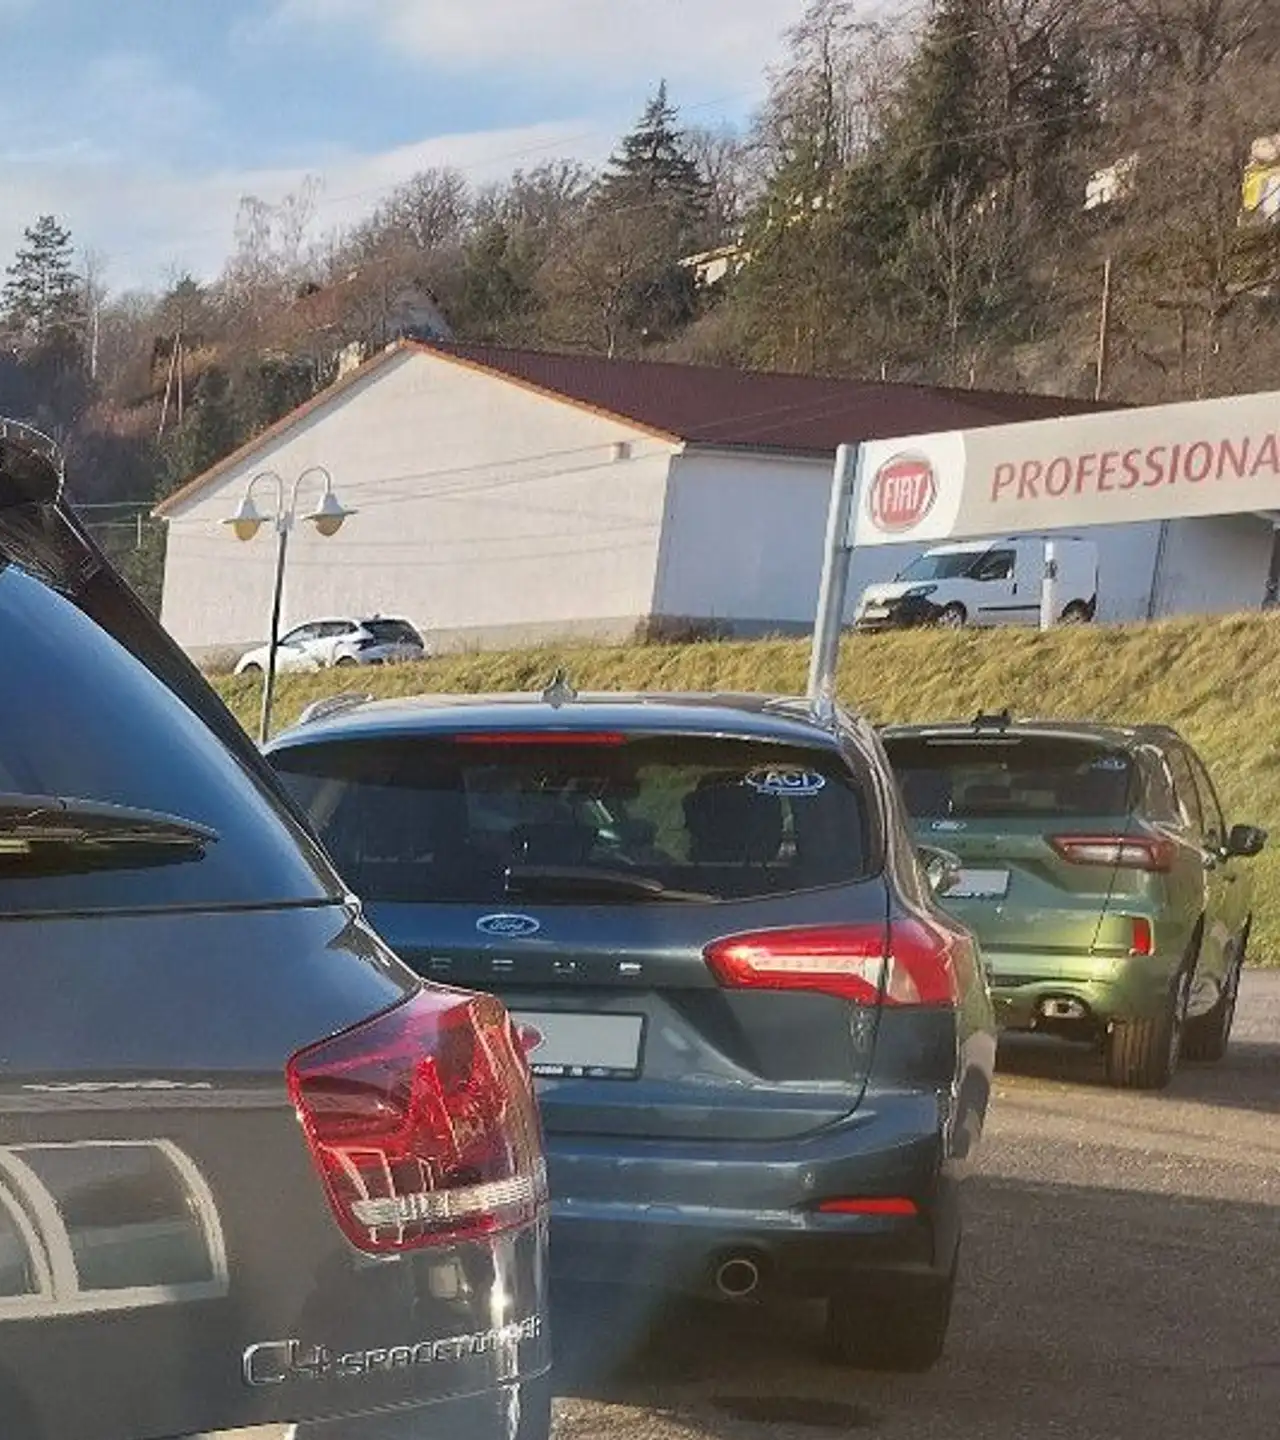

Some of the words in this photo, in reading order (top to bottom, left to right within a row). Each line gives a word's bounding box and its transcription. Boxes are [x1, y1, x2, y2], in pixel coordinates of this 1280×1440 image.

[883, 473, 924, 513] FIAT
[991, 432, 1280, 503] PROFESSIONA
[243, 1339, 331, 1386] C4
